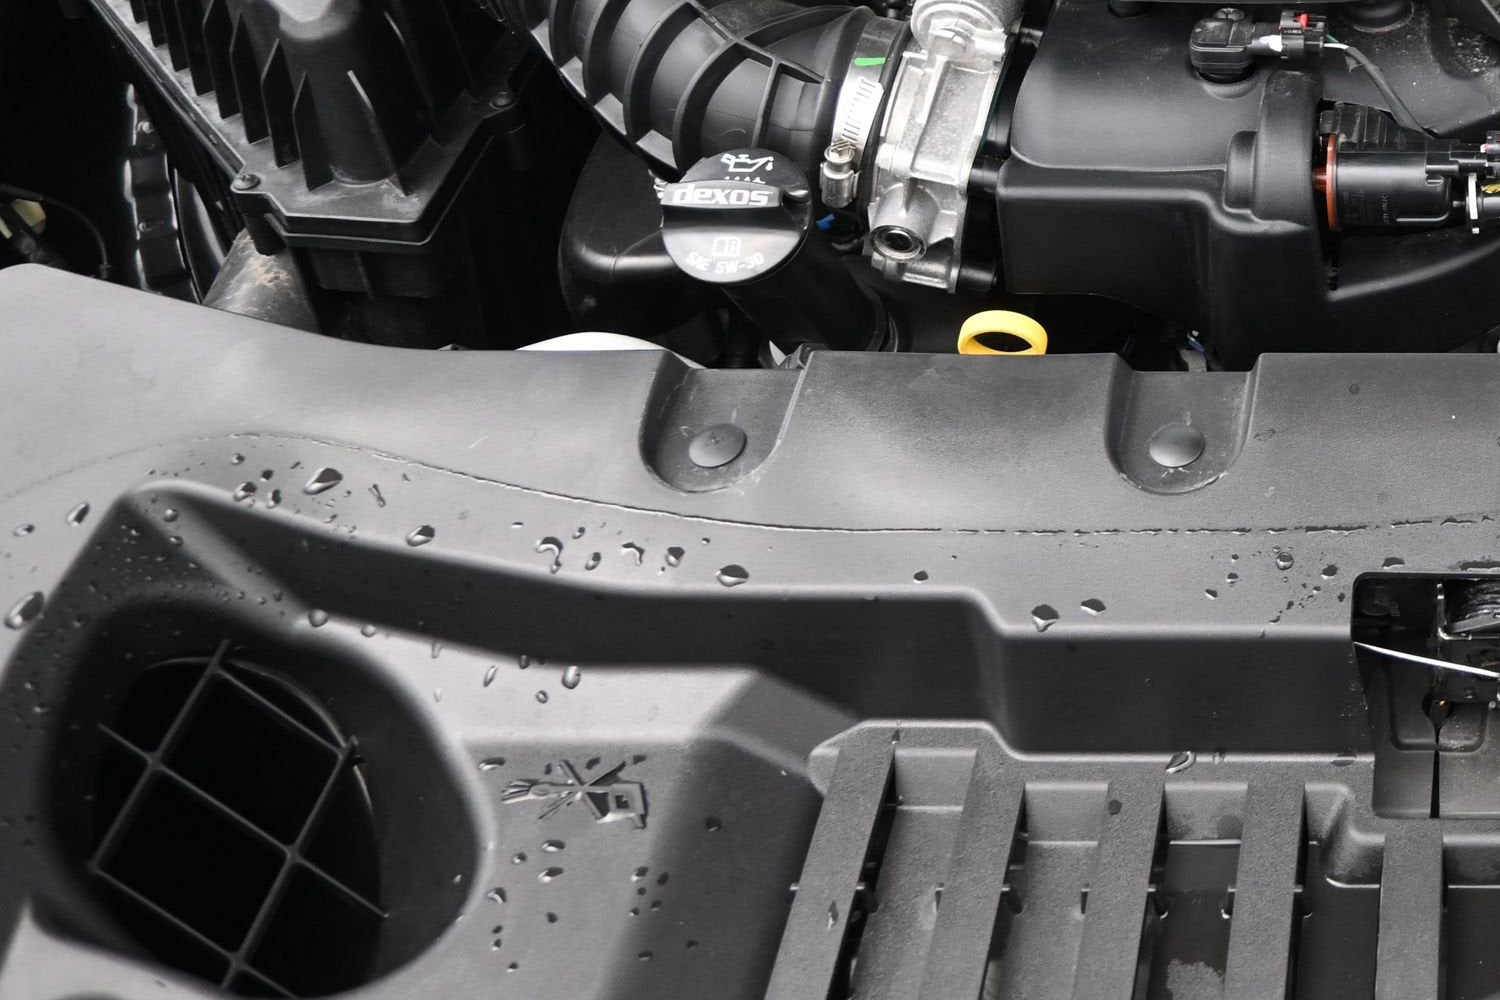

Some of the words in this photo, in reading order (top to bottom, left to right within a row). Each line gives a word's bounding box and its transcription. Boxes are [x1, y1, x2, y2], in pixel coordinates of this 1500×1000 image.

[672, 183, 774, 207] dexos
[686, 250, 713, 272] SAE
[715, 251, 765, 275] 5W-30
